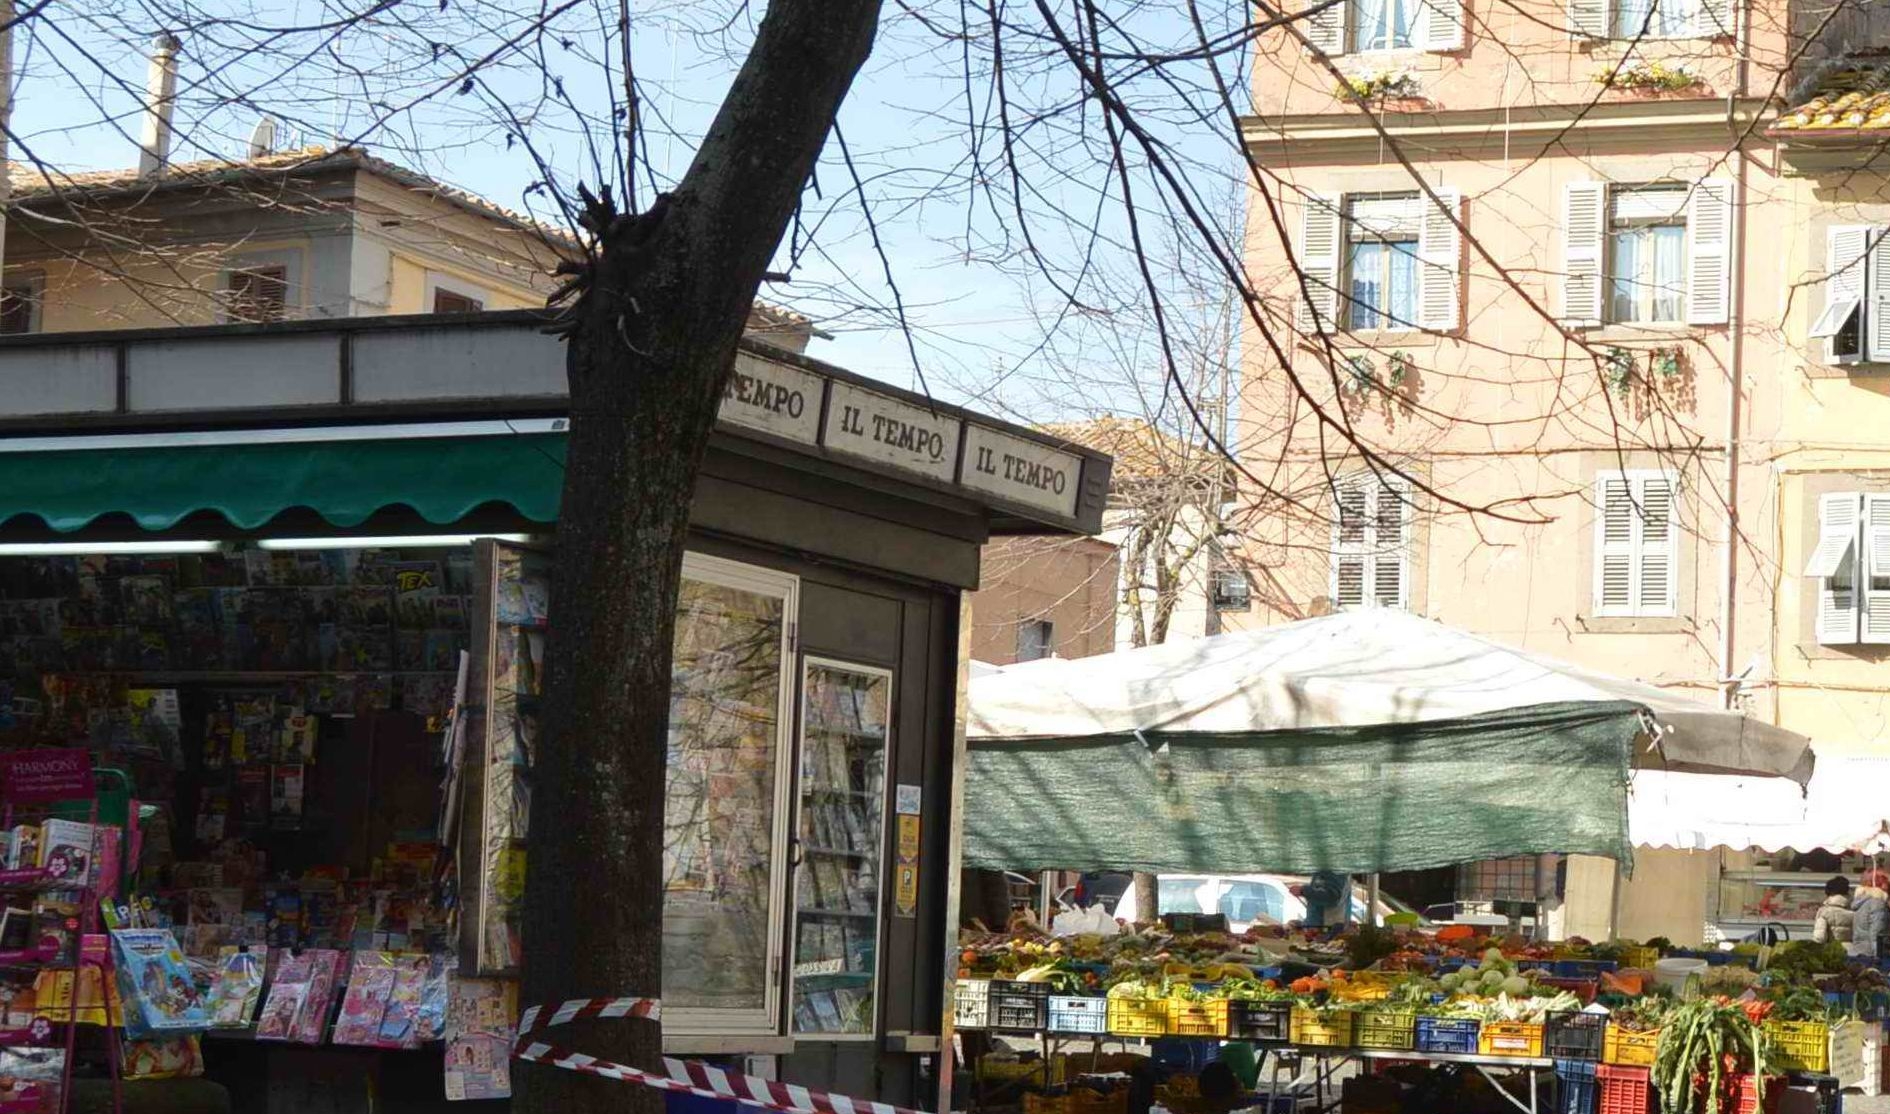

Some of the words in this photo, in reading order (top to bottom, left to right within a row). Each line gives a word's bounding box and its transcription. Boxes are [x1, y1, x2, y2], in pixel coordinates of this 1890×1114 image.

[841, 405, 864, 438] IL
[873, 416, 943, 458] TEMPO
[975, 446, 996, 474] IL
[1003, 454, 1066, 496] TEMPO
[397, 569, 432, 591] TEX
[12, 759, 80, 775] HARMONY
